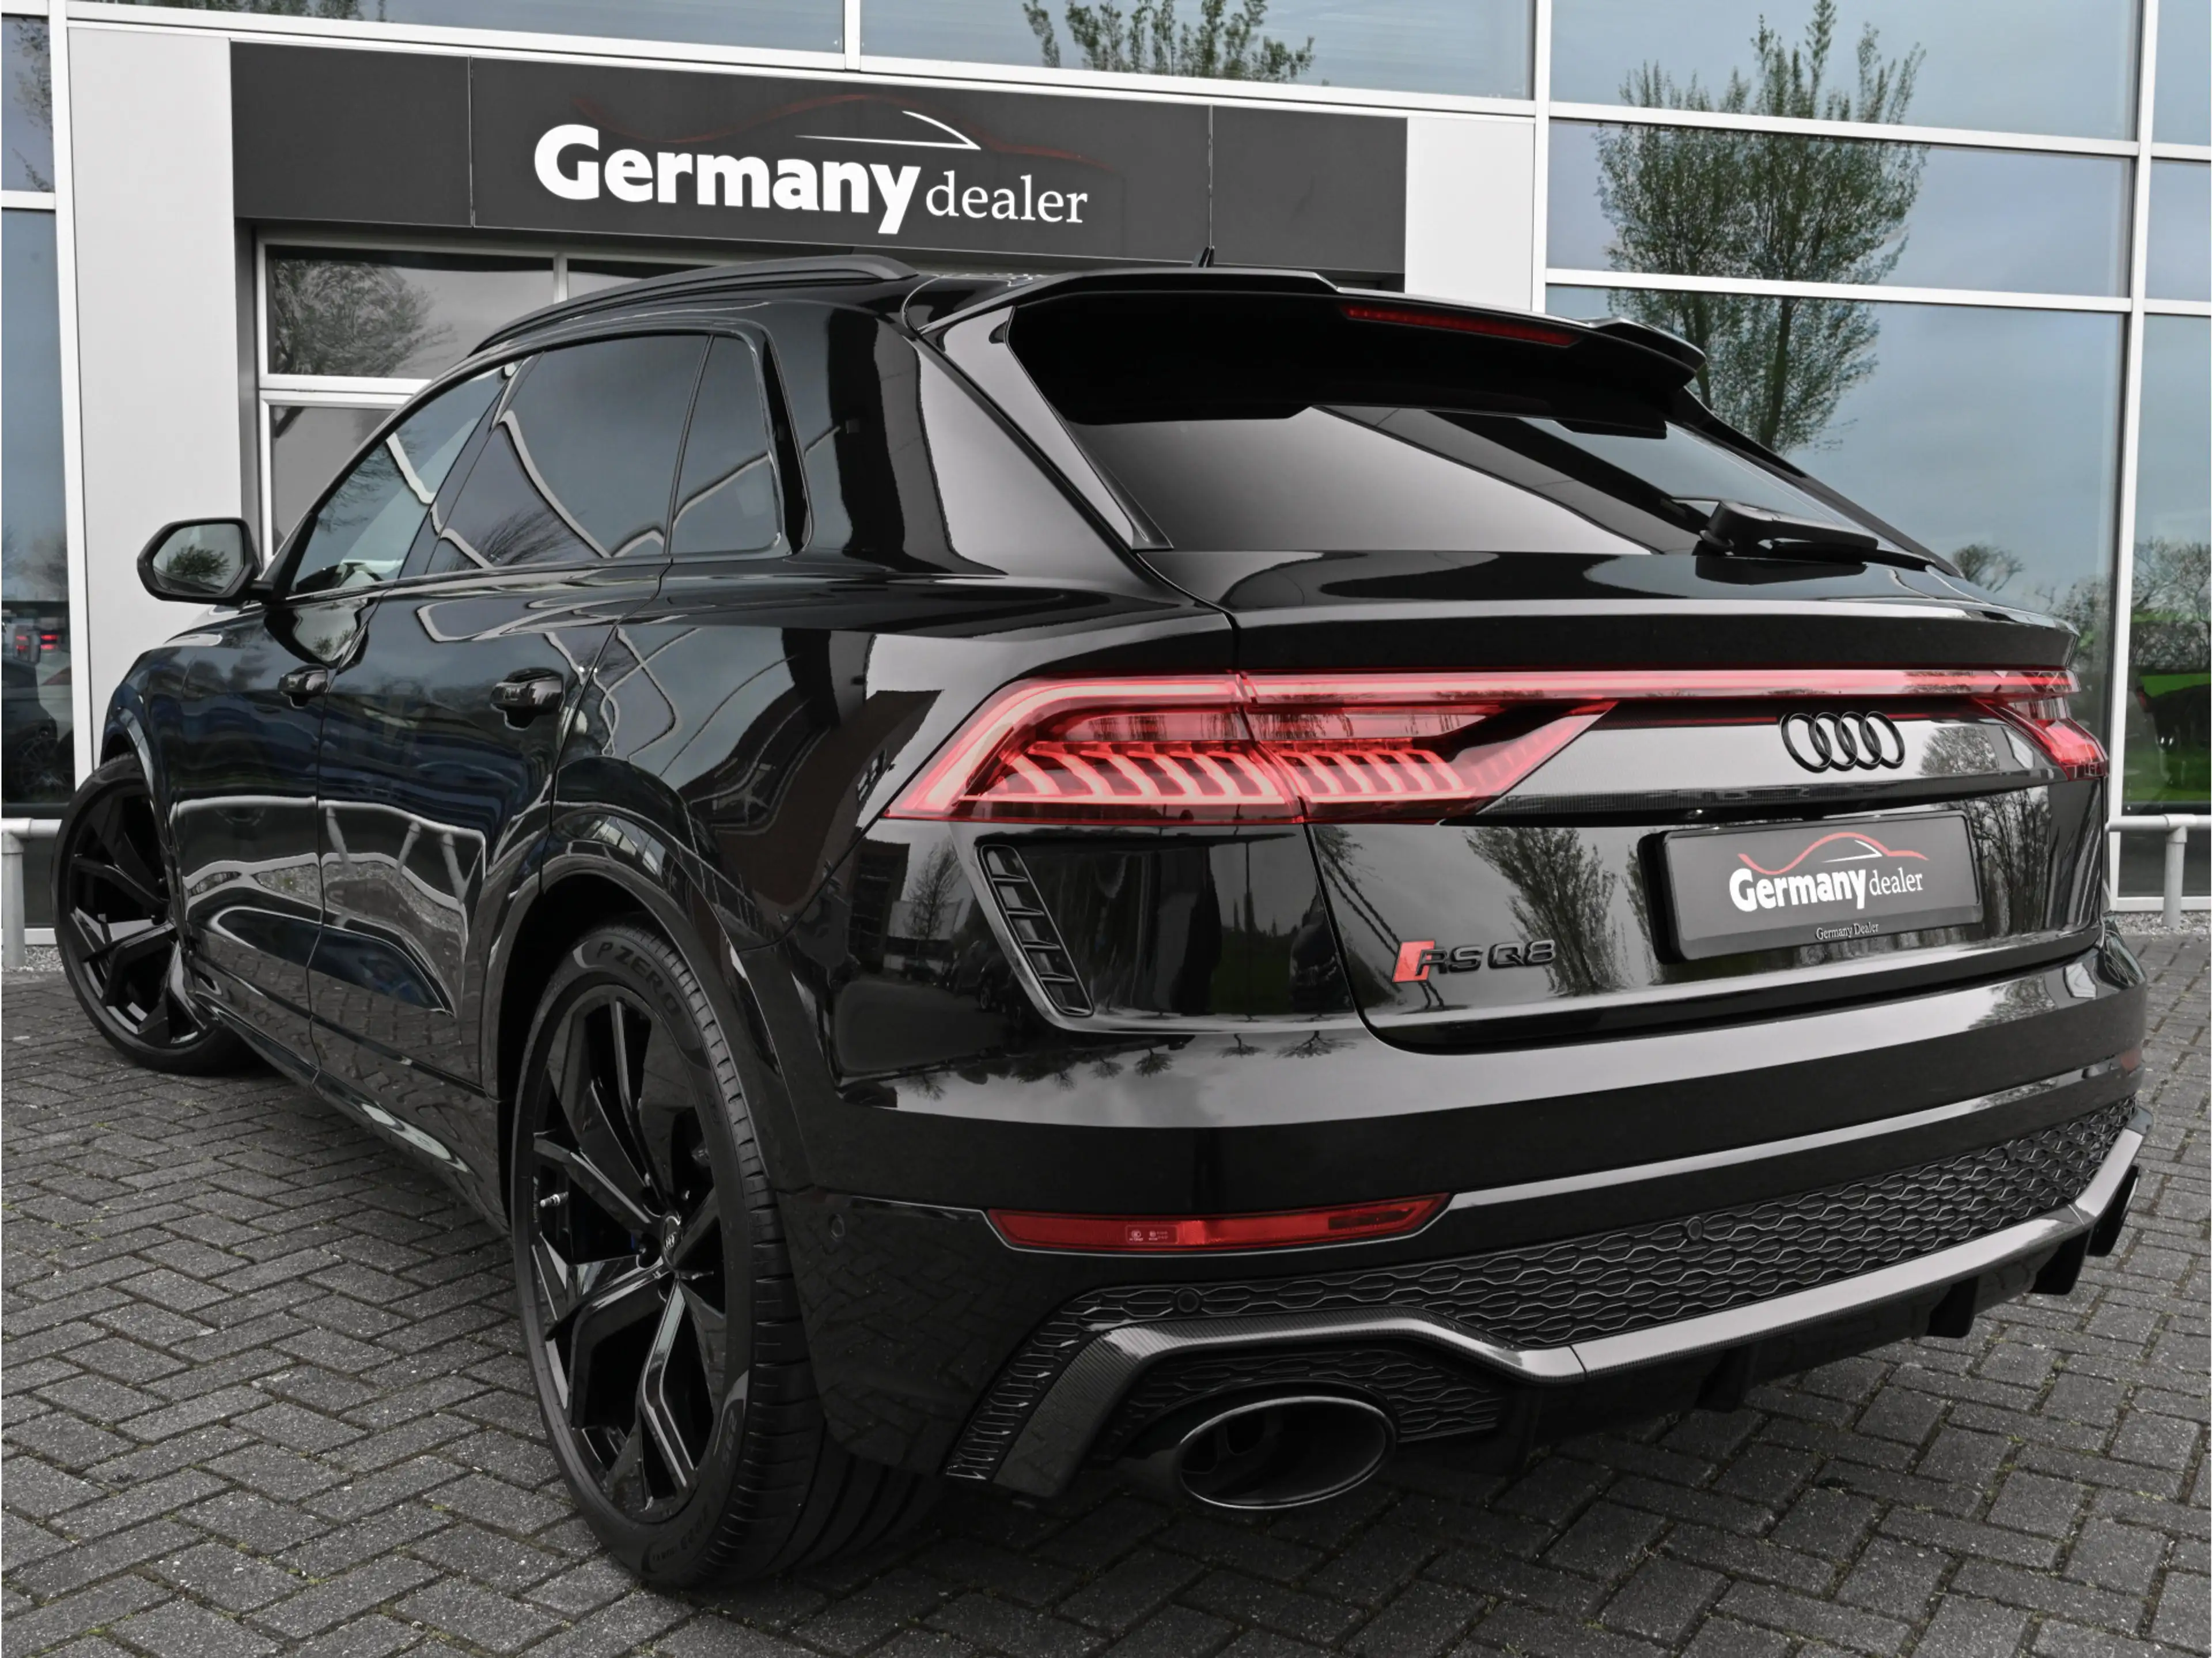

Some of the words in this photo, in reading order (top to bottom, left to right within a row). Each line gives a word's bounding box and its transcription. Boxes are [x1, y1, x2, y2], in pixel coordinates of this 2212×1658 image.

[534, 124, 921, 234] Germany
[925, 171, 1088, 225] dealer
[1729, 868, 1866, 913] Germany
[1869, 868, 1923, 896] dealer
[1816, 927, 1853, 940] Germany
[1853, 921, 1879, 935] Dealer
[614, 945, 681, 1016] ZERO
